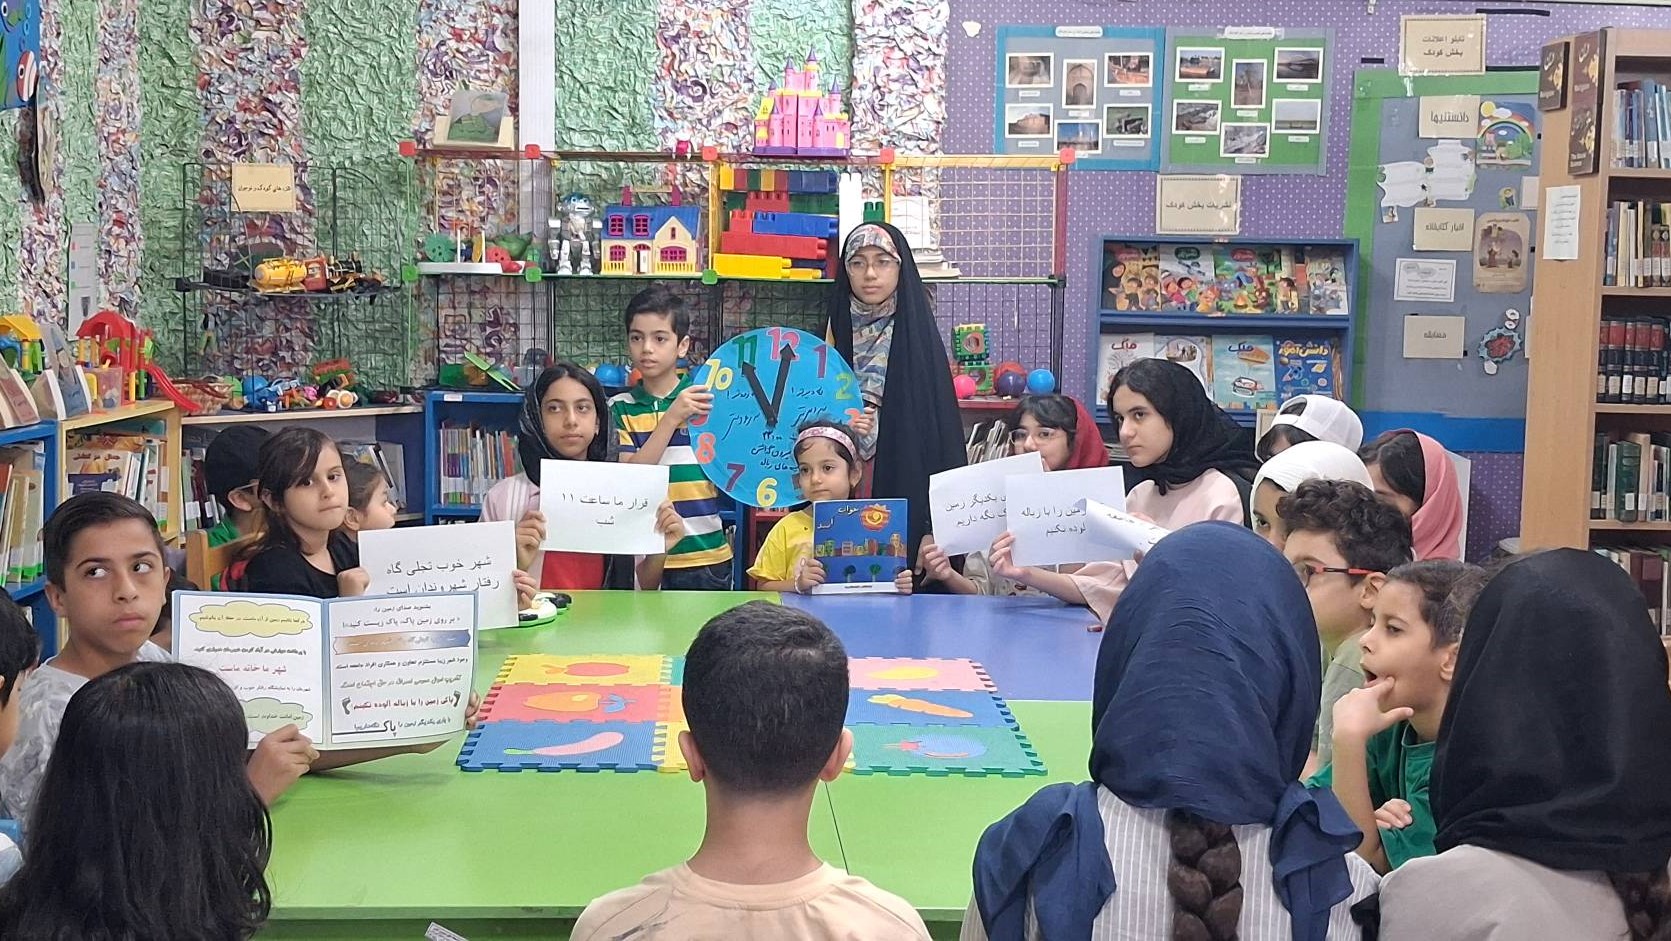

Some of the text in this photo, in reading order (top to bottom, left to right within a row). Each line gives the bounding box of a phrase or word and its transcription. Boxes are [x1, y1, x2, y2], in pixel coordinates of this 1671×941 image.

[1423, 47, 1464, 57] بخش کودک
[1165, 200, 1232, 210] نشریات بخش کودک
[767, 327, 801, 361] 12
[732, 334, 758, 369] 11
[704, 358, 734, 392] 10
[835, 373, 855, 401] 2
[696, 431, 716, 464] 8
[725, 462, 746, 493] 7
[756, 476, 778, 508] 6
[561, 492, 649, 511] قرار ما ساعت ۱۱
[945, 501, 966, 512] زمین
[970, 492, 998, 509] یکدیگر
[979, 509, 996, 521] نگه
[1021, 506, 1041, 519] زباله
[1043, 505, 1051, 518] با
[1053, 505, 1063, 518] را
[595, 515, 615, 528] شب
[957, 514, 978, 528] داریم
[1068, 521, 1087, 535] لوده
[385, 555, 492, 577] شهر خوب تجلی گاه
[386, 583, 411, 595] است
[473, 576, 500, 592] رفتار
[363, 619, 385, 628] زیست
[385, 617, 399, 627] پاک
[416, 617, 433, 626] زمین
[219, 663, 287, 676] شهر ما خانه ماست
[393, 698, 409, 708] زباله
[410, 697, 417, 707] با
[425, 697, 439, 707] زمین
